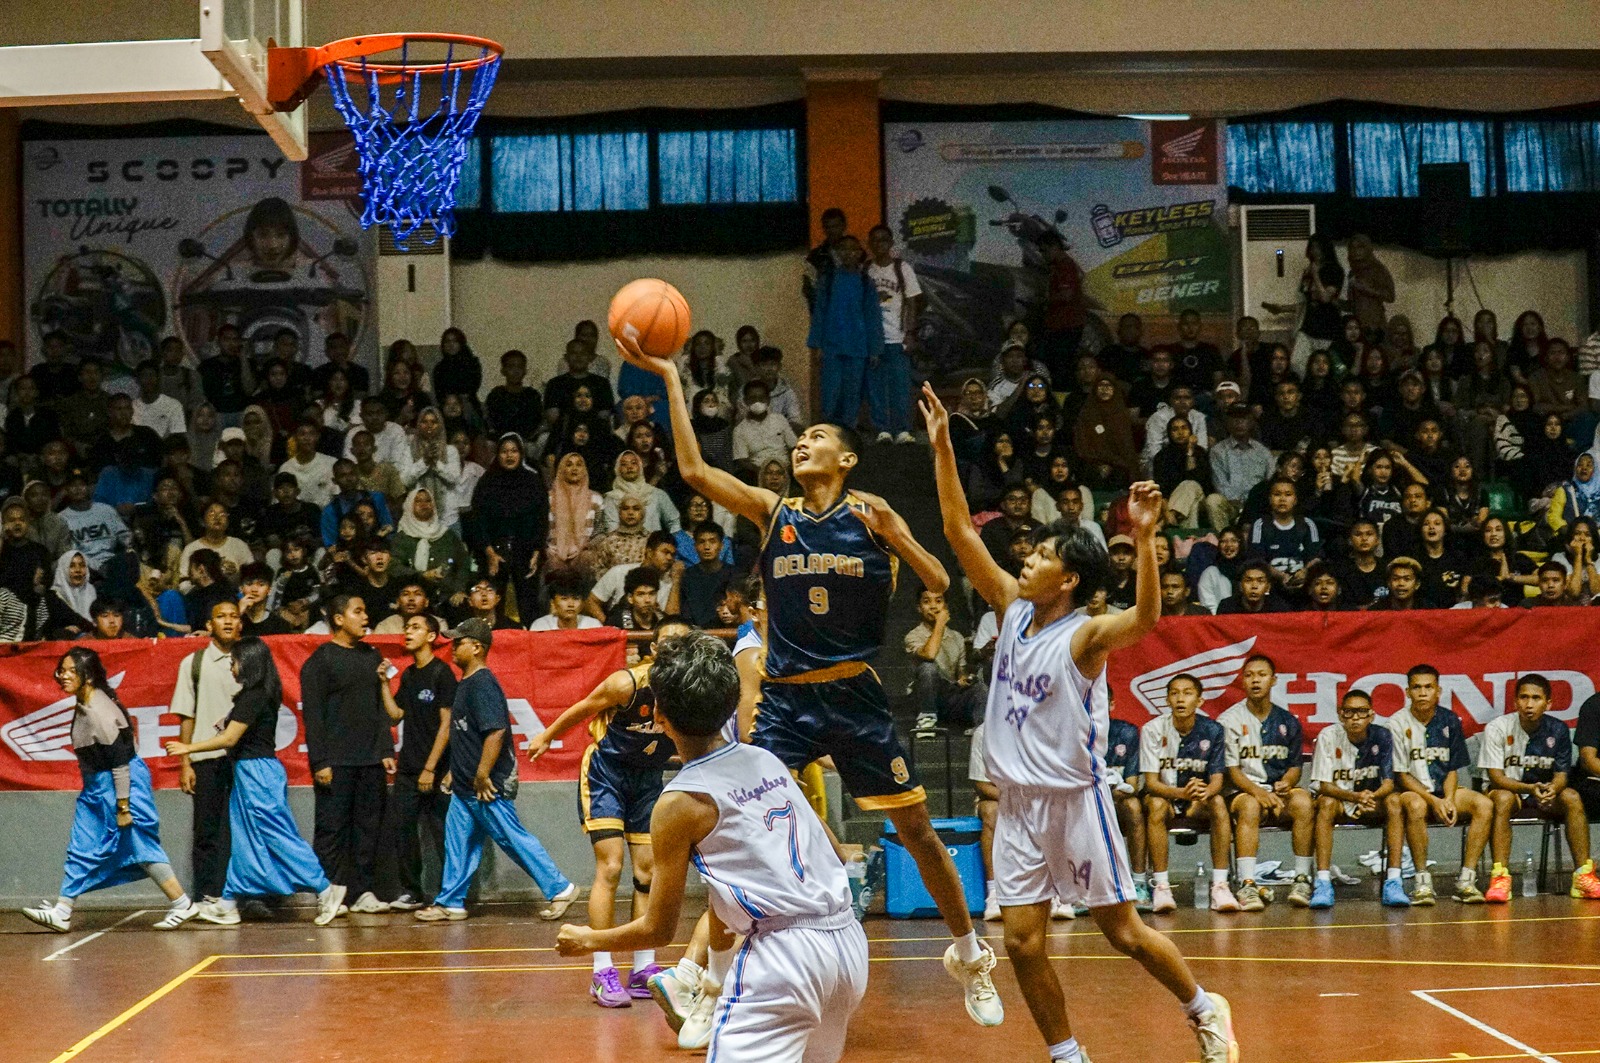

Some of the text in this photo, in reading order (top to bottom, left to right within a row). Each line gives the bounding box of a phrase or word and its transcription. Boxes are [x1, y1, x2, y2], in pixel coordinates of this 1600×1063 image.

[86, 157, 285, 183] SCOOPY
[69, 214, 180, 243] Unique
[1114, 200, 1214, 228] KEYLESS
[772, 552, 865, 579] DELAPAN
[808, 586, 830, 615] 9
[890, 756, 910, 785] 9
[763, 800, 805, 883] 7
